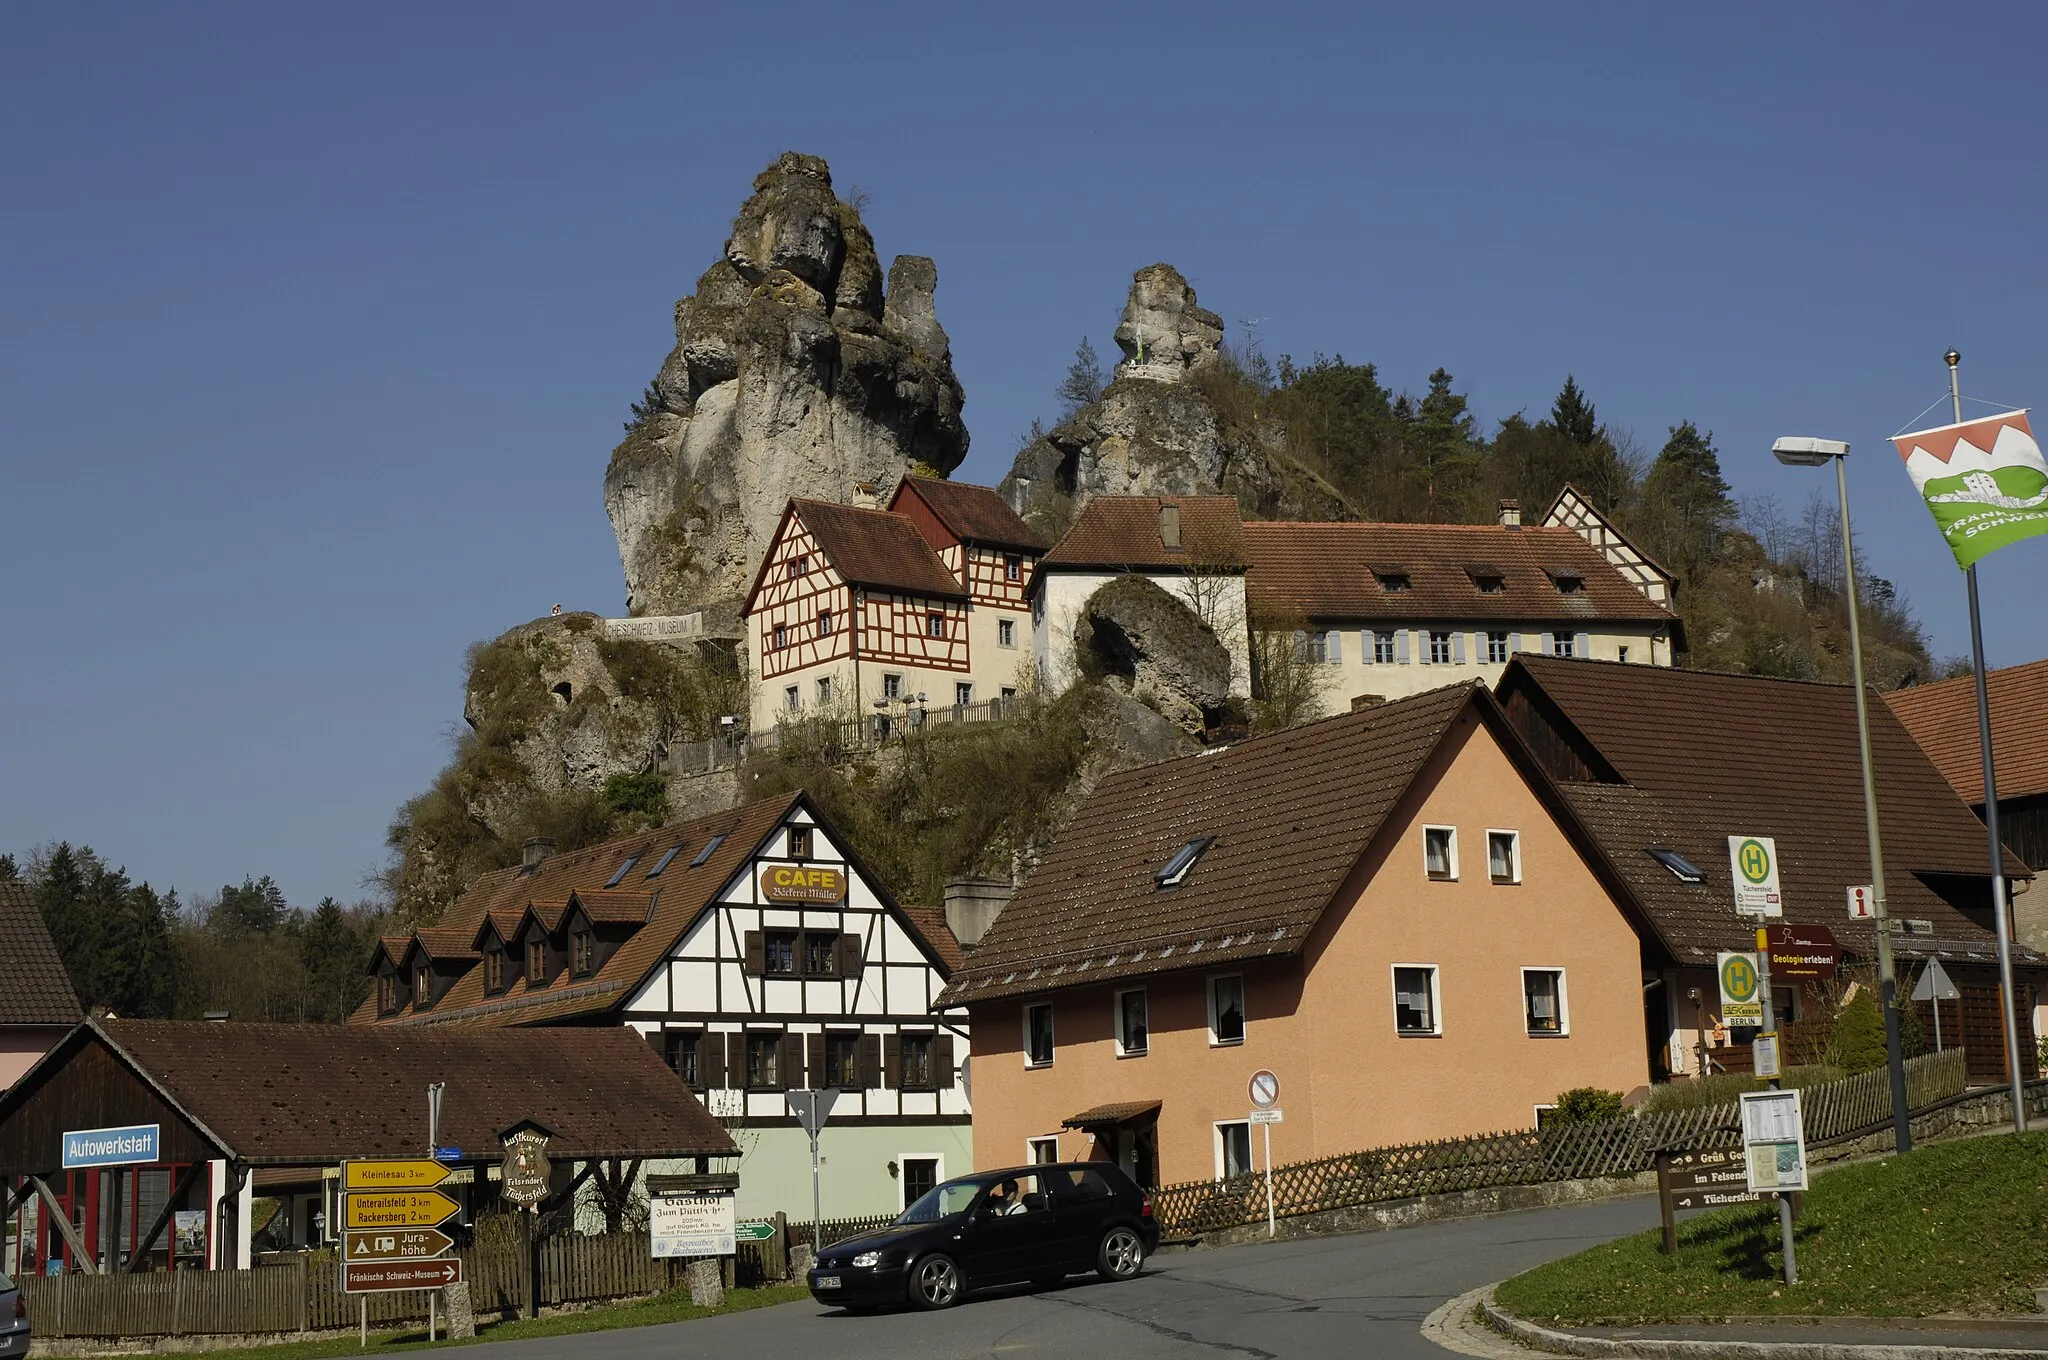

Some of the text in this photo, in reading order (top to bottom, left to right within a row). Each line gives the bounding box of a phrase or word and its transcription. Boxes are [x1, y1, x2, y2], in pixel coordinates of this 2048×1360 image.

[659, 620, 687, 634] MUSEUM
[1746, 850, 1762, 873] H
[774, 869, 835, 888] CAFE
[773, 887, 837, 899] Bäckerei Müller
[1773, 955, 1833, 965] Geologie erleben!
[1731, 967, 1748, 991] H
[1730, 1018, 1756, 1026] BERLIN
[503, 1131, 549, 1148] Luftkurort
[69, 1134, 152, 1158] Autowerkstatt
[1700, 1151, 1747, 1163] Grüß Got
[362, 1169, 406, 1179] Kleinlesau
[409, 1169, 414, 1178] 3
[1694, 1169, 1748, 1184] im Felsend
[507, 1176, 544, 1186] Felsendorf
[506, 1184, 548, 1202] Tüchersfeld
[1703, 1191, 1760, 1204] Tüchersfeld
[356, 1197, 431, 1209] Unterailsfeld 3 km
[664, 1195, 722, 1206] Gasthof
[358, 1210, 431, 1223] Rackersberg 2 km
[656, 1208, 677, 1218] Zum
[401, 1232, 429, 1243] Jura-
[401, 1245, 427, 1256] höhe
[349, 1269, 440, 1282] Fränkische Schweiz-Museum
